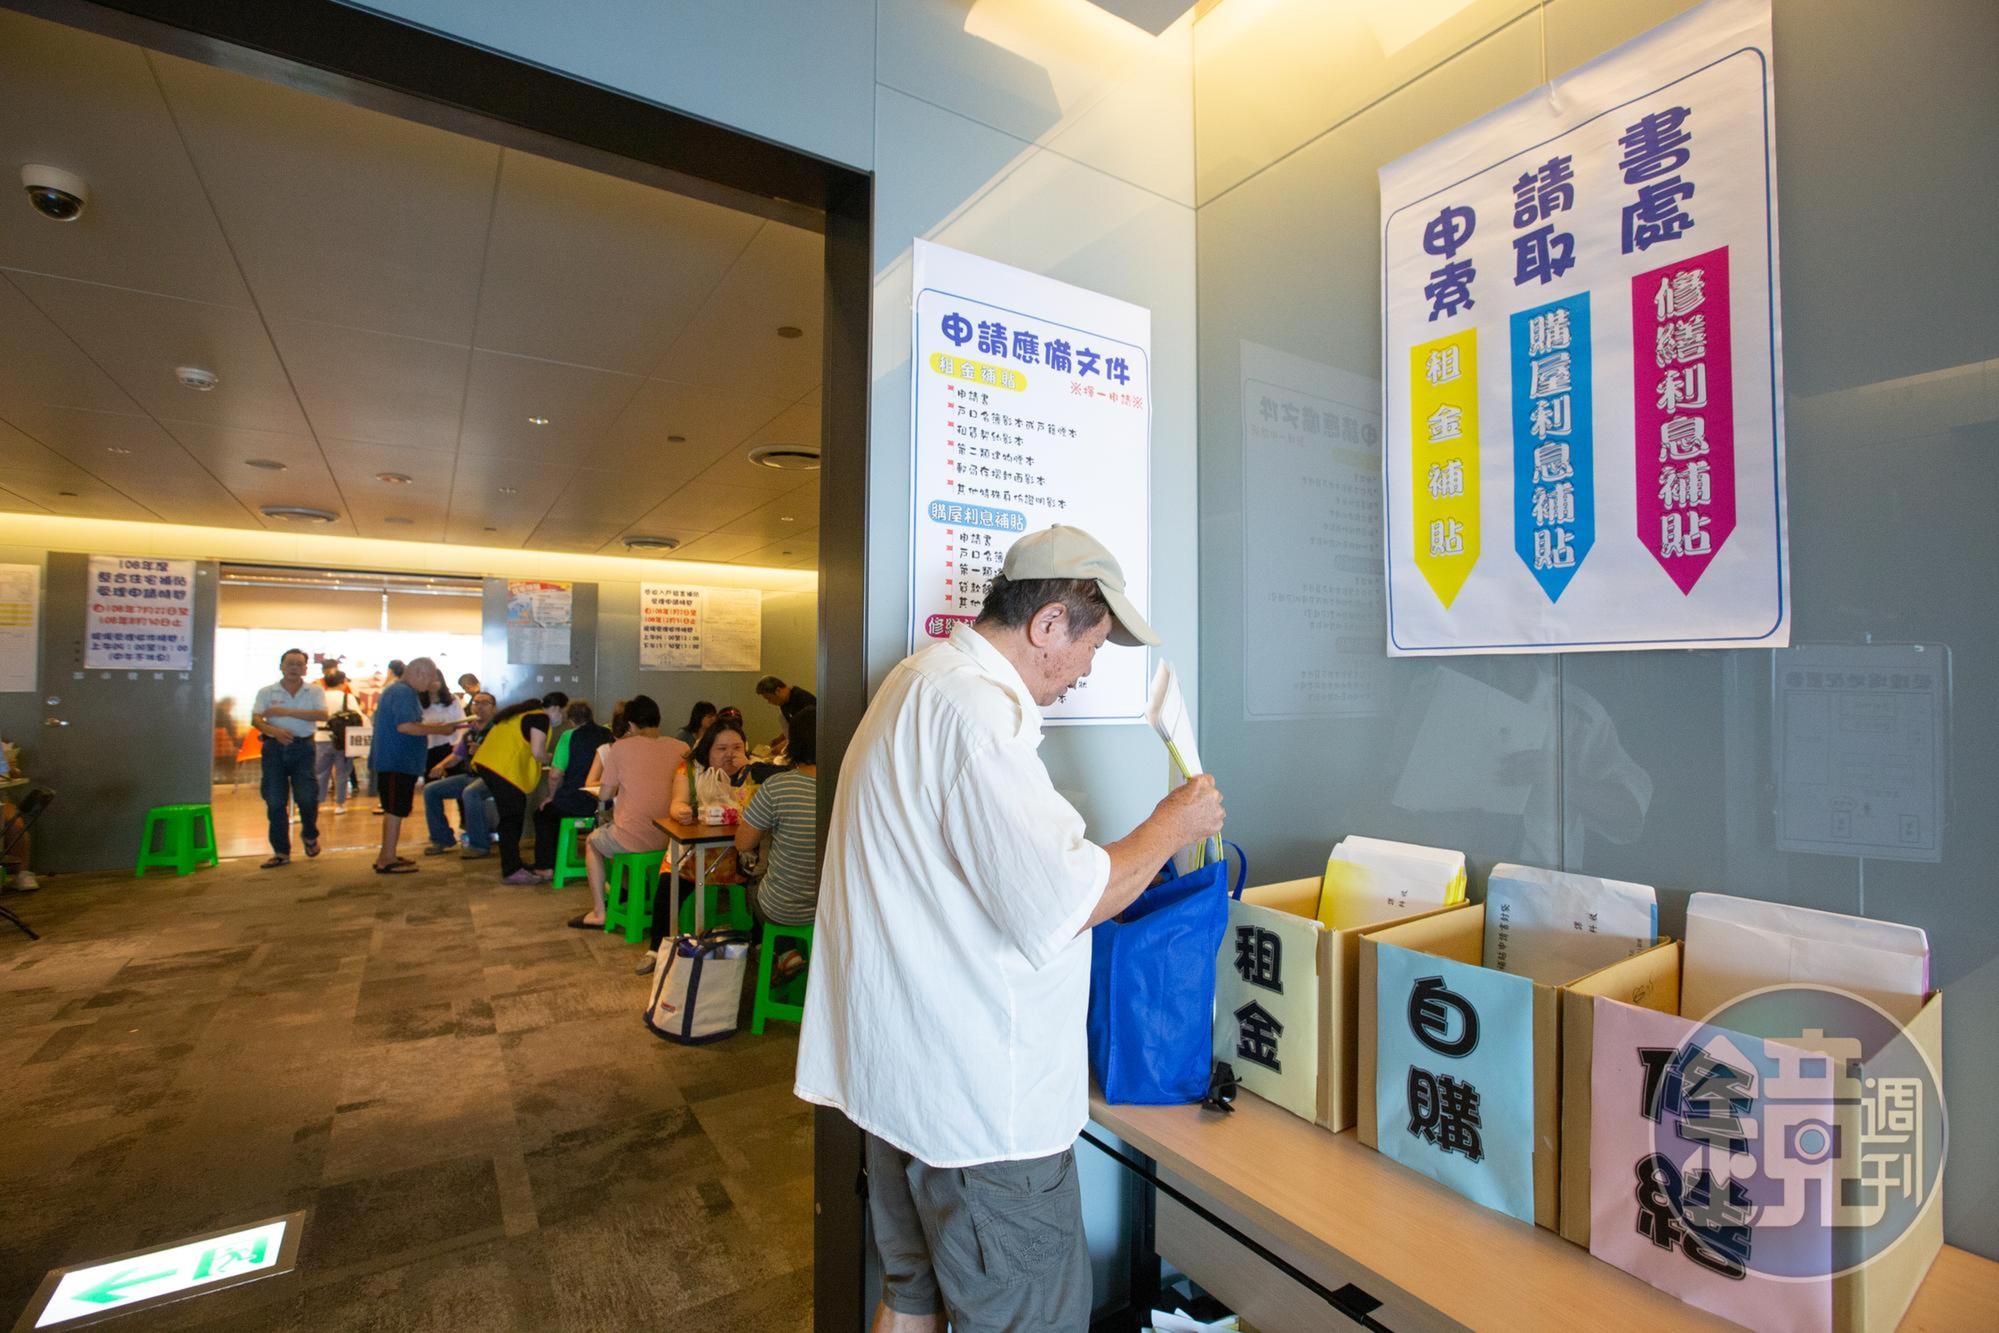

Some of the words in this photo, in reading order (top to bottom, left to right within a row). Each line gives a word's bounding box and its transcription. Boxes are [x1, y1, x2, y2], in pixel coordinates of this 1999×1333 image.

[938, 354, 1017, 389] 租金補貼
[941, 311, 1131, 386] 申請應備文件
[957, 389, 989, 406] 申請書
[1653, 264, 1712, 560] 修繕利息補貼
[957, 442, 1035, 466] 第二類建物謄本
[1424, 344, 1464, 557] 租金補貼
[1527, 308, 1576, 571] 購屋利息補貼
[956, 462, 1046, 486] 郵局存摺封面影本
[931, 502, 1024, 531] 購屋利息補貼
[959, 533, 992, 546] 申請書
[1232, 923, 1284, 1075] 租金
[1406, 974, 1485, 1164] 自購
